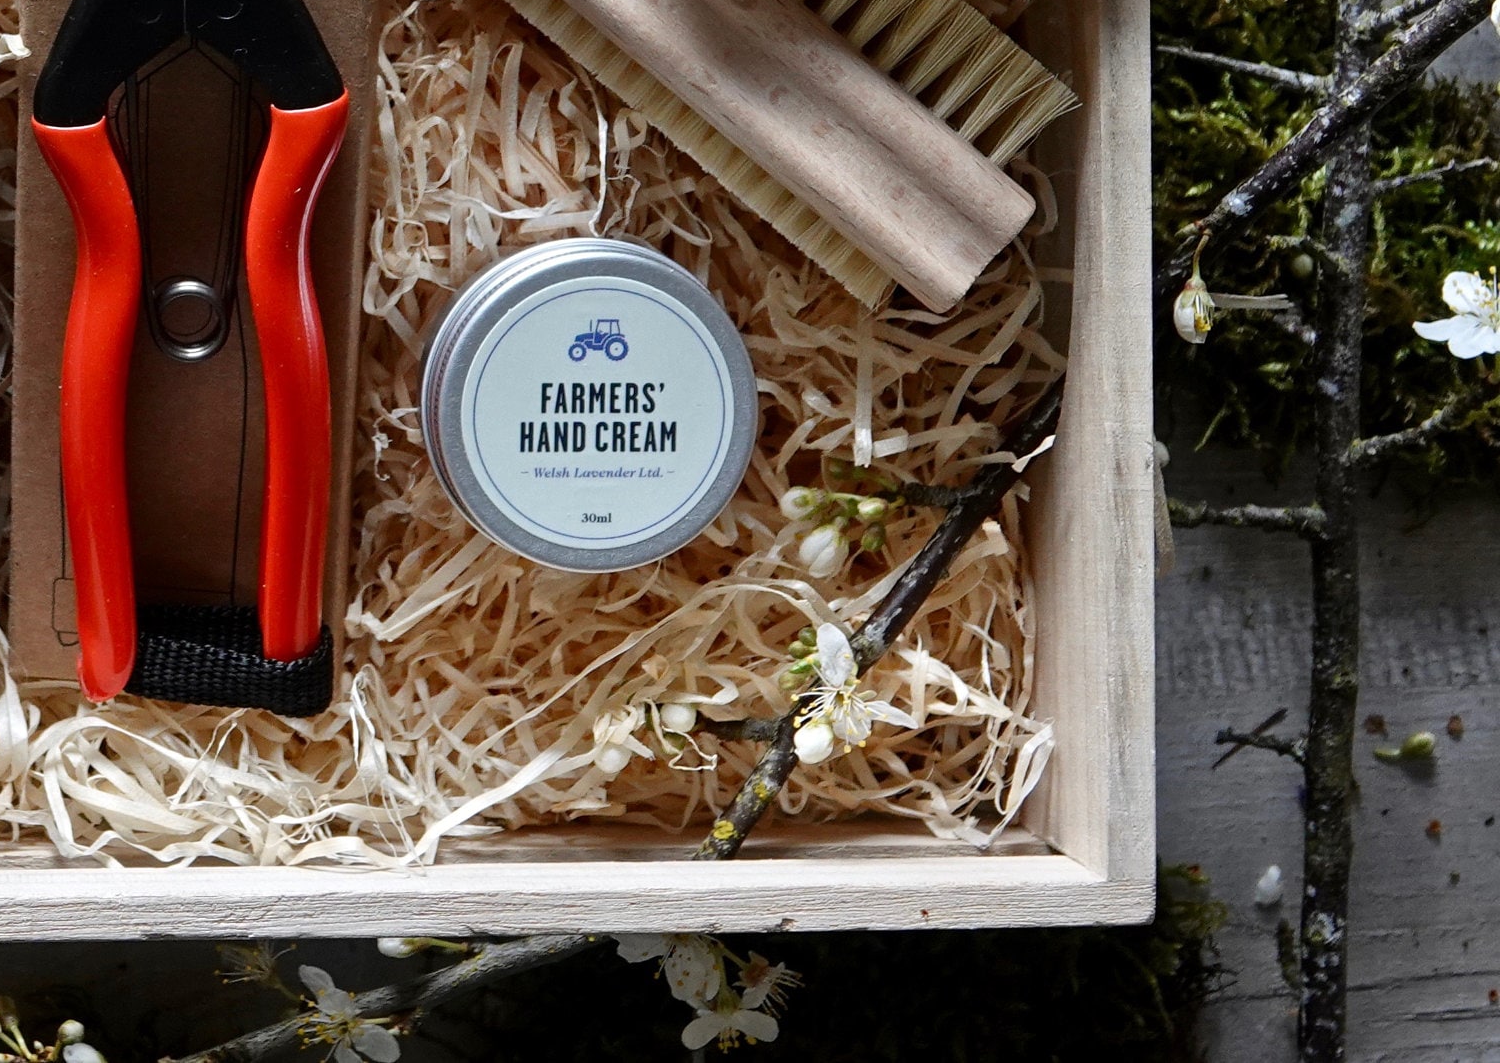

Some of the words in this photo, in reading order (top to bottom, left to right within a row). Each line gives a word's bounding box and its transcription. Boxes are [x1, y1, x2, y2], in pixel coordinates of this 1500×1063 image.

[520, 421, 587, 453] HAND
[595, 421, 677, 453] CREAM
[534, 467, 570, 478] Welsh
[574, 467, 637, 478] Lavender
[639, 467, 664, 478] Ltd.
[581, 512, 612, 523] 30ml
